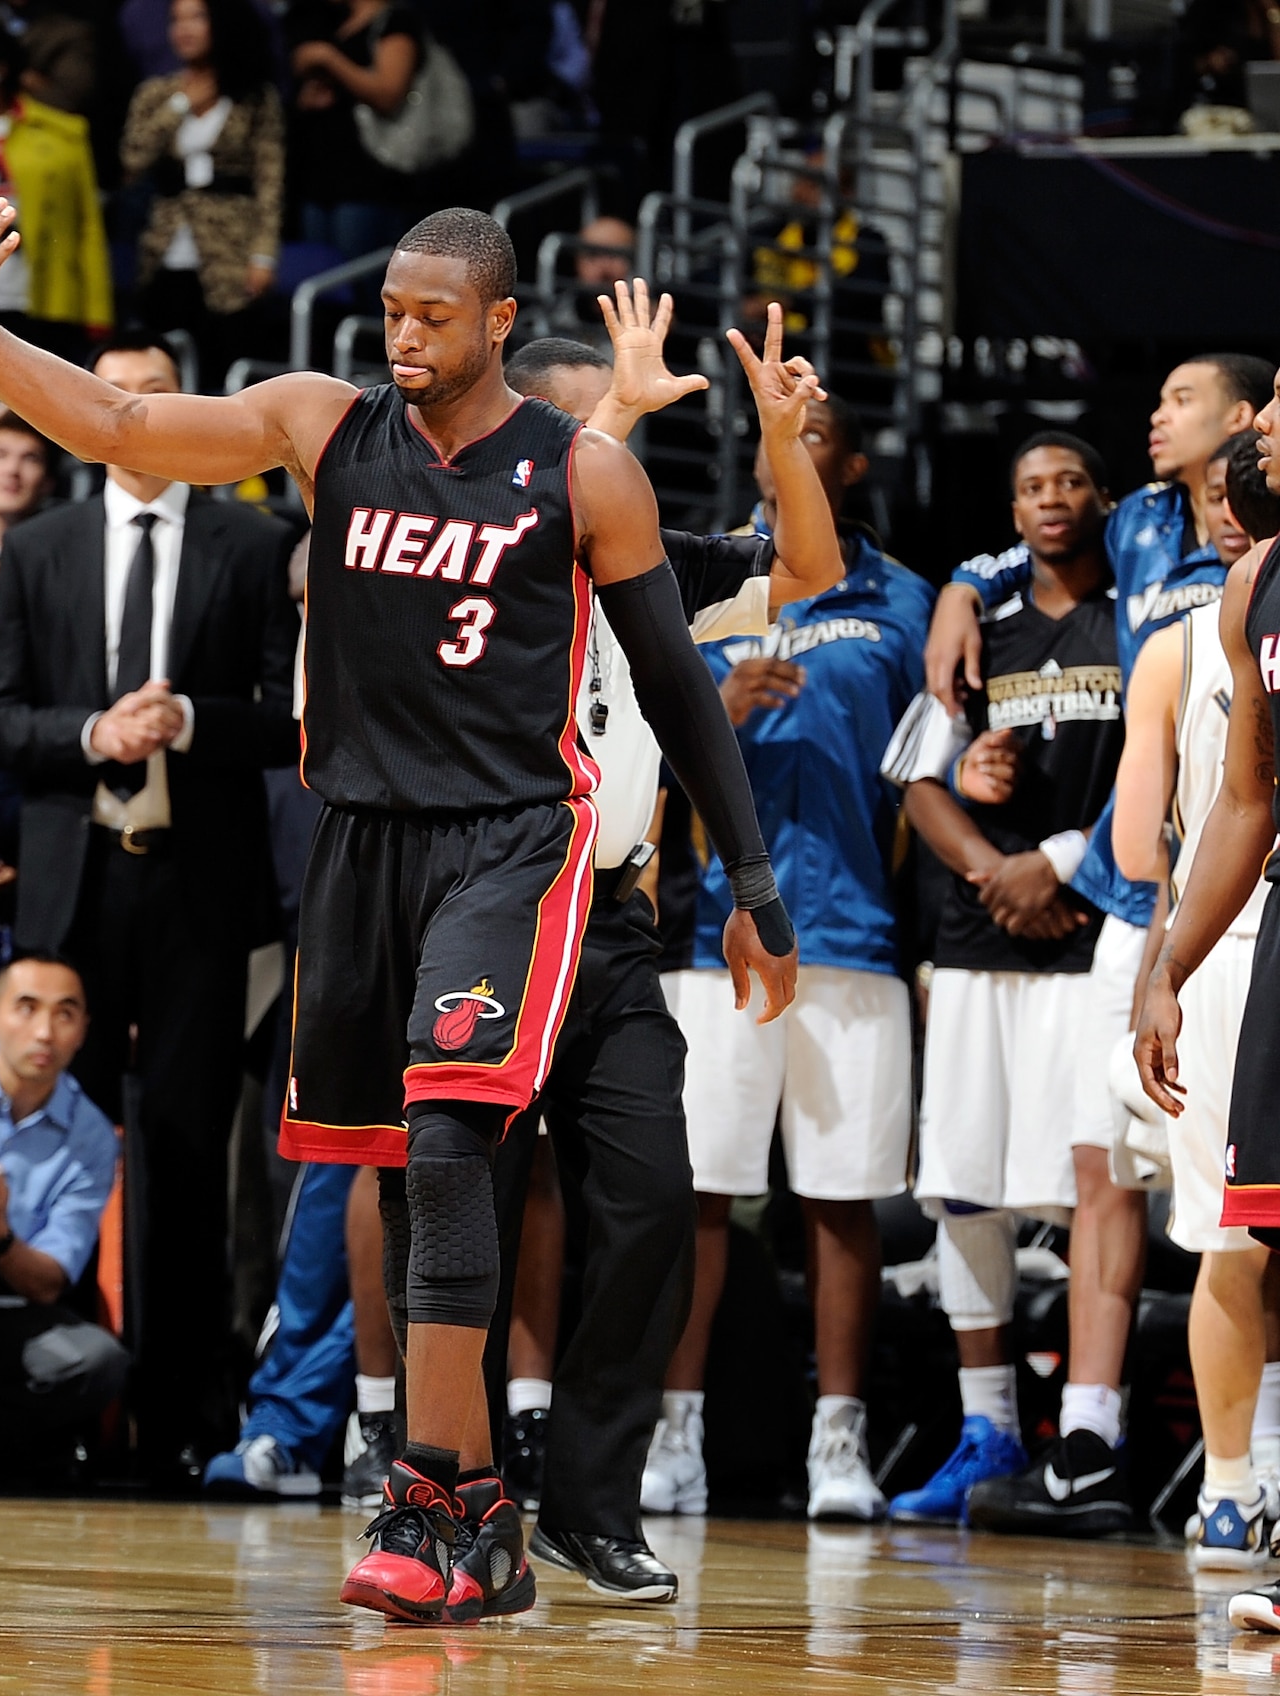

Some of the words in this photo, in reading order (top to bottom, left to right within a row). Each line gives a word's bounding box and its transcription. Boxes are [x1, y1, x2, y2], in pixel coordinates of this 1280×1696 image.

[344, 507, 540, 588] HEAT
[436, 594, 498, 668] 3
[987, 669, 1122, 703] WASHINGTON
[988, 690, 1120, 729] BASKETBALL
